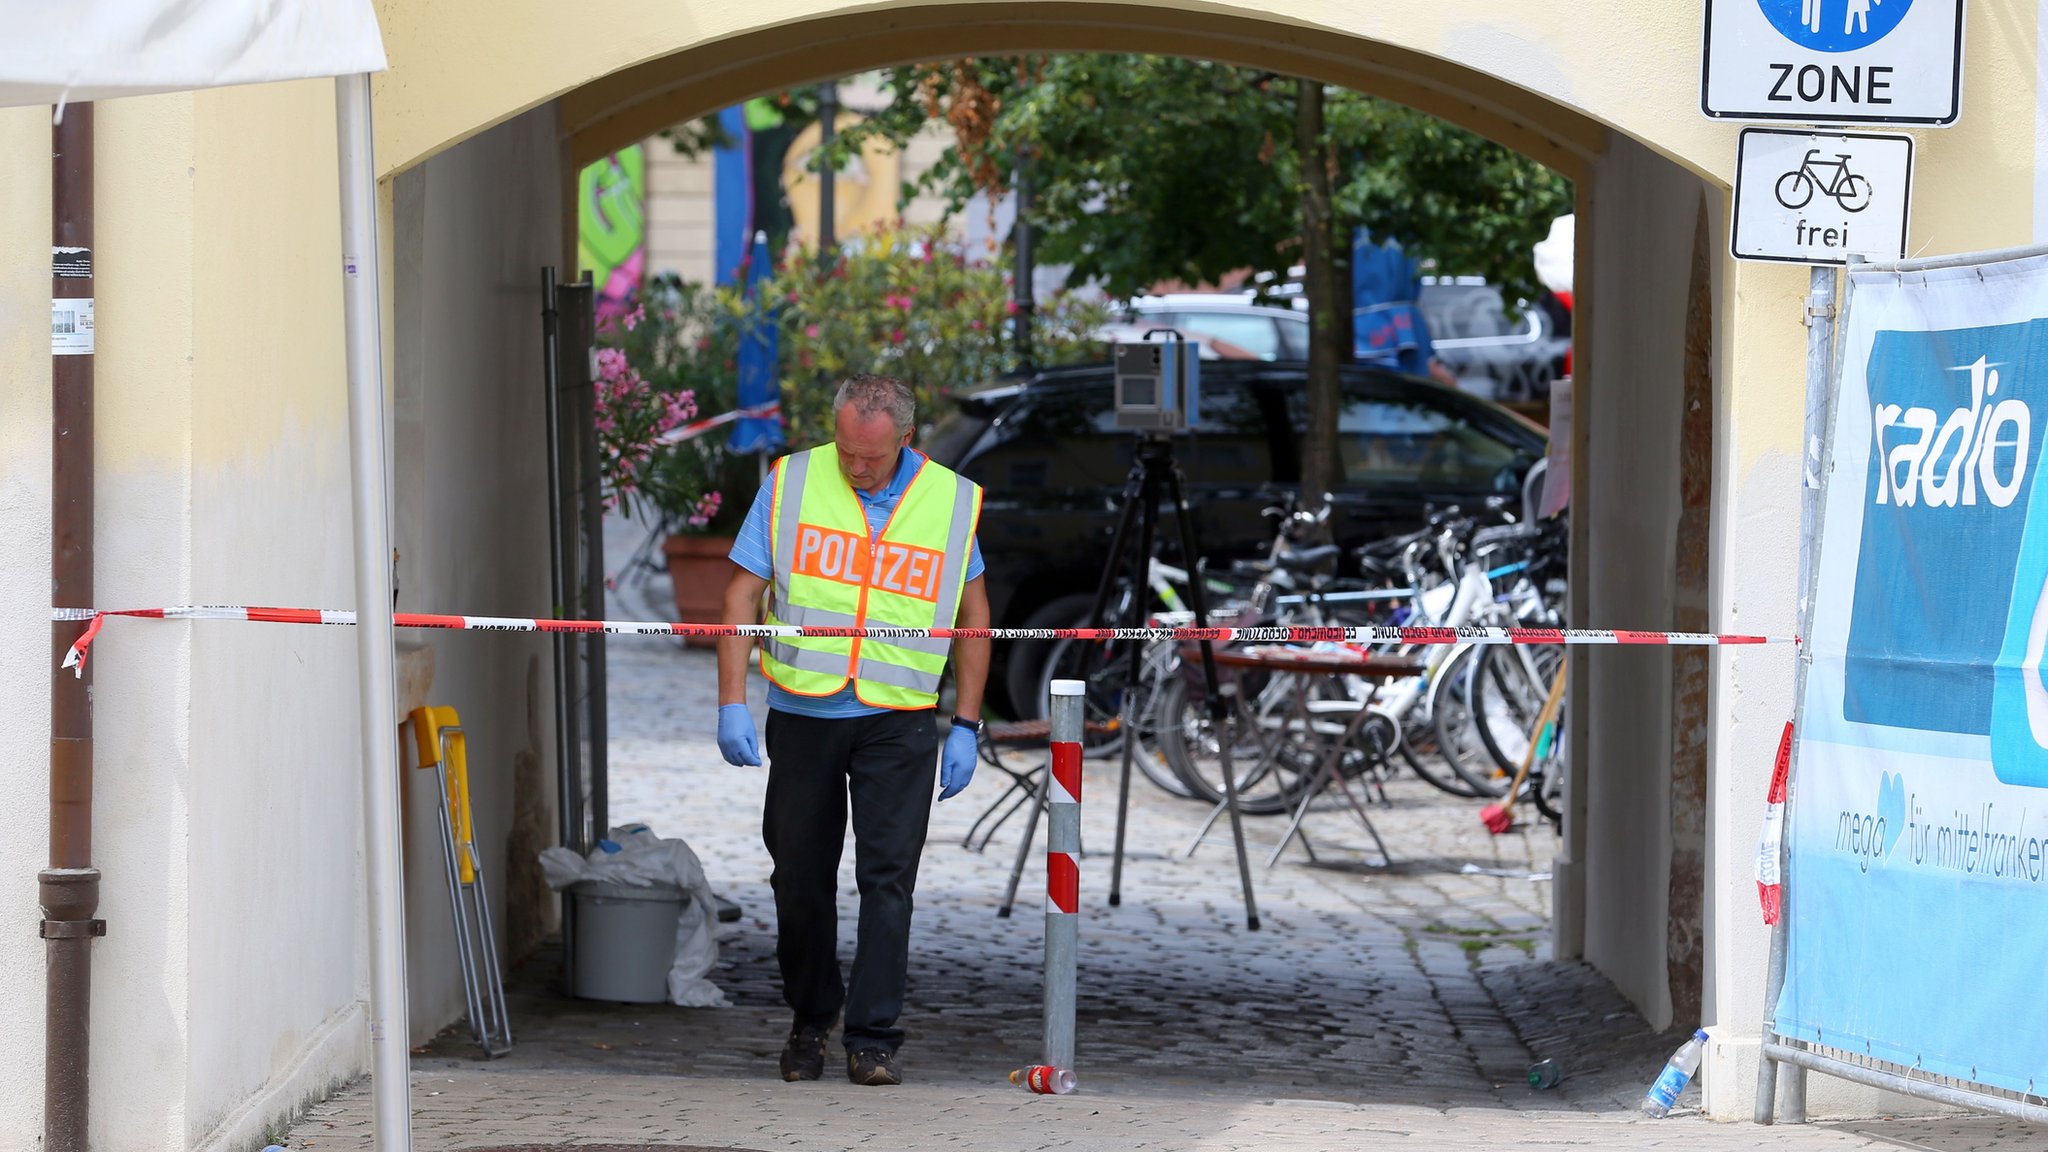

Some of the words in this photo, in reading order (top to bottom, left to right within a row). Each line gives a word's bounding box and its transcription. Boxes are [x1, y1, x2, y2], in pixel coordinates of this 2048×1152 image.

[1767, 63, 1893, 104] ZONE
[1796, 219, 1848, 249] frei
[1875, 354, 2031, 508] radio
[800, 529, 939, 597] POLIZEI
[1835, 810, 1888, 874] mega
[1908, 792, 1931, 865] für
